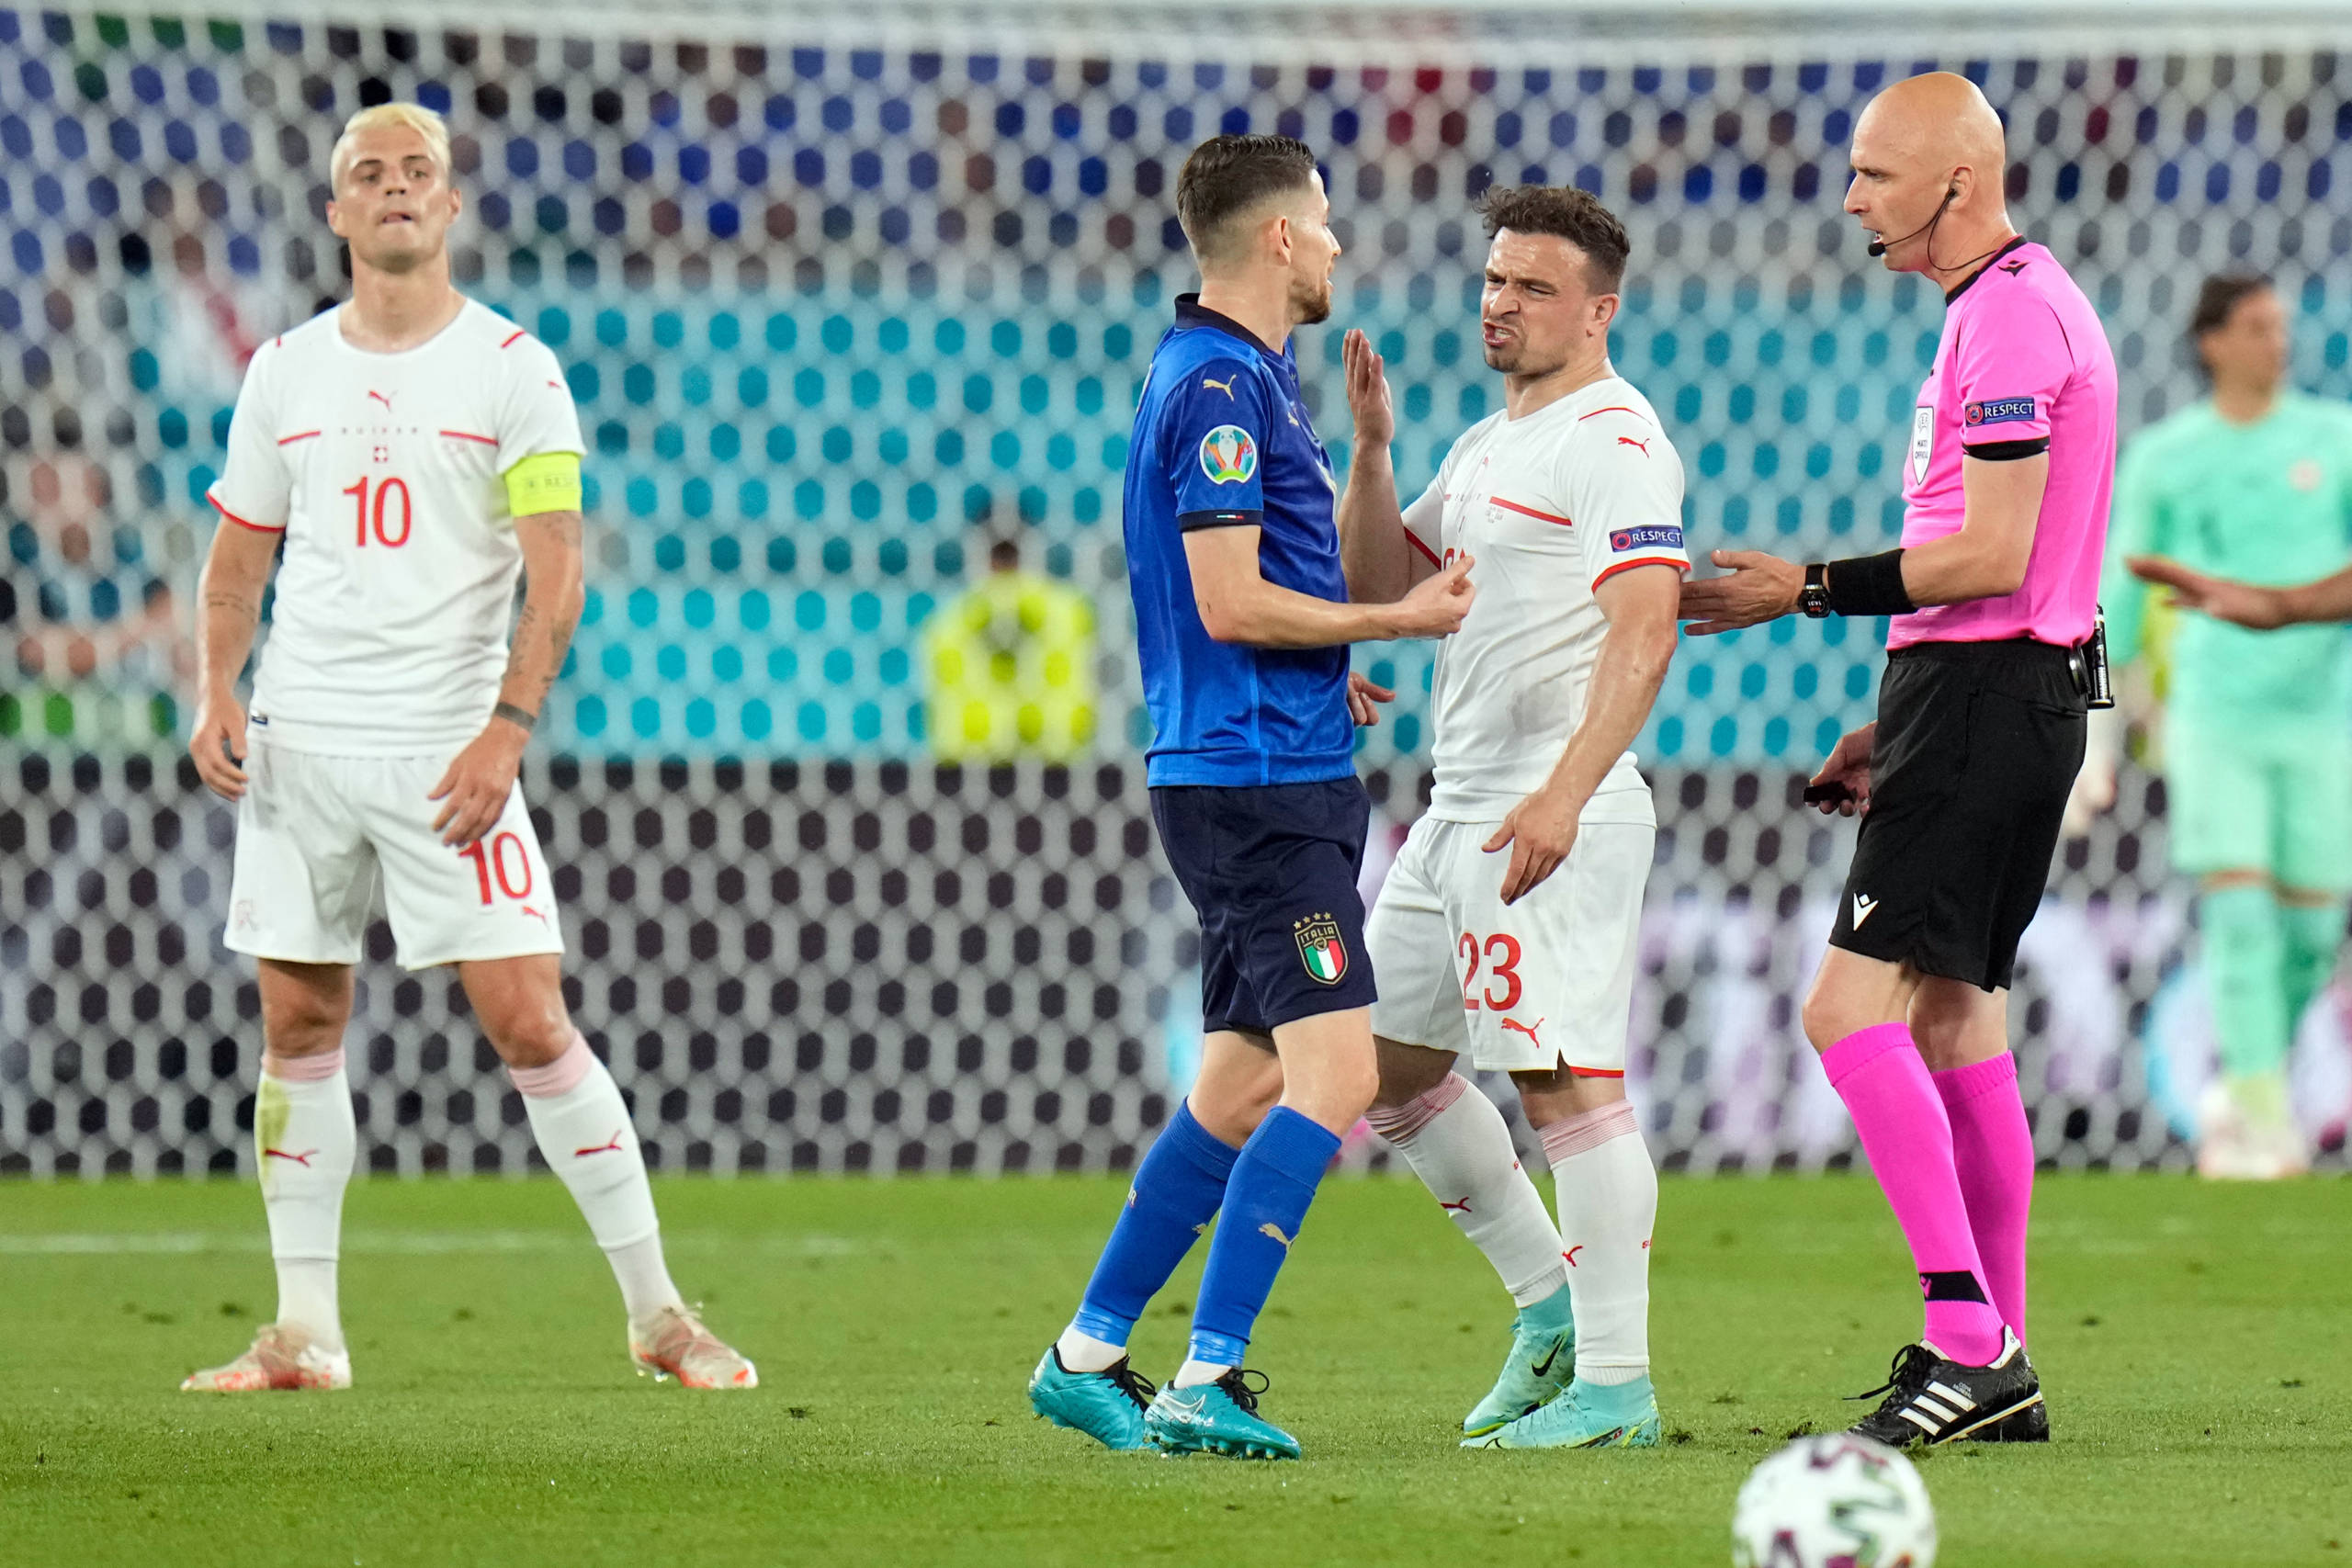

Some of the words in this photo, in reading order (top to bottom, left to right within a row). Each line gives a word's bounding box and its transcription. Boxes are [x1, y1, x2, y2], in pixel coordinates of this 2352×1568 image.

[1984, 402, 2034, 418] RESPECT
[343, 476, 412, 548] 10
[1632, 530, 1681, 543] RESPECT
[458, 831, 533, 906] 10
[1300, 926, 1335, 944] ITALIA
[1458, 931, 1522, 1011] 23
